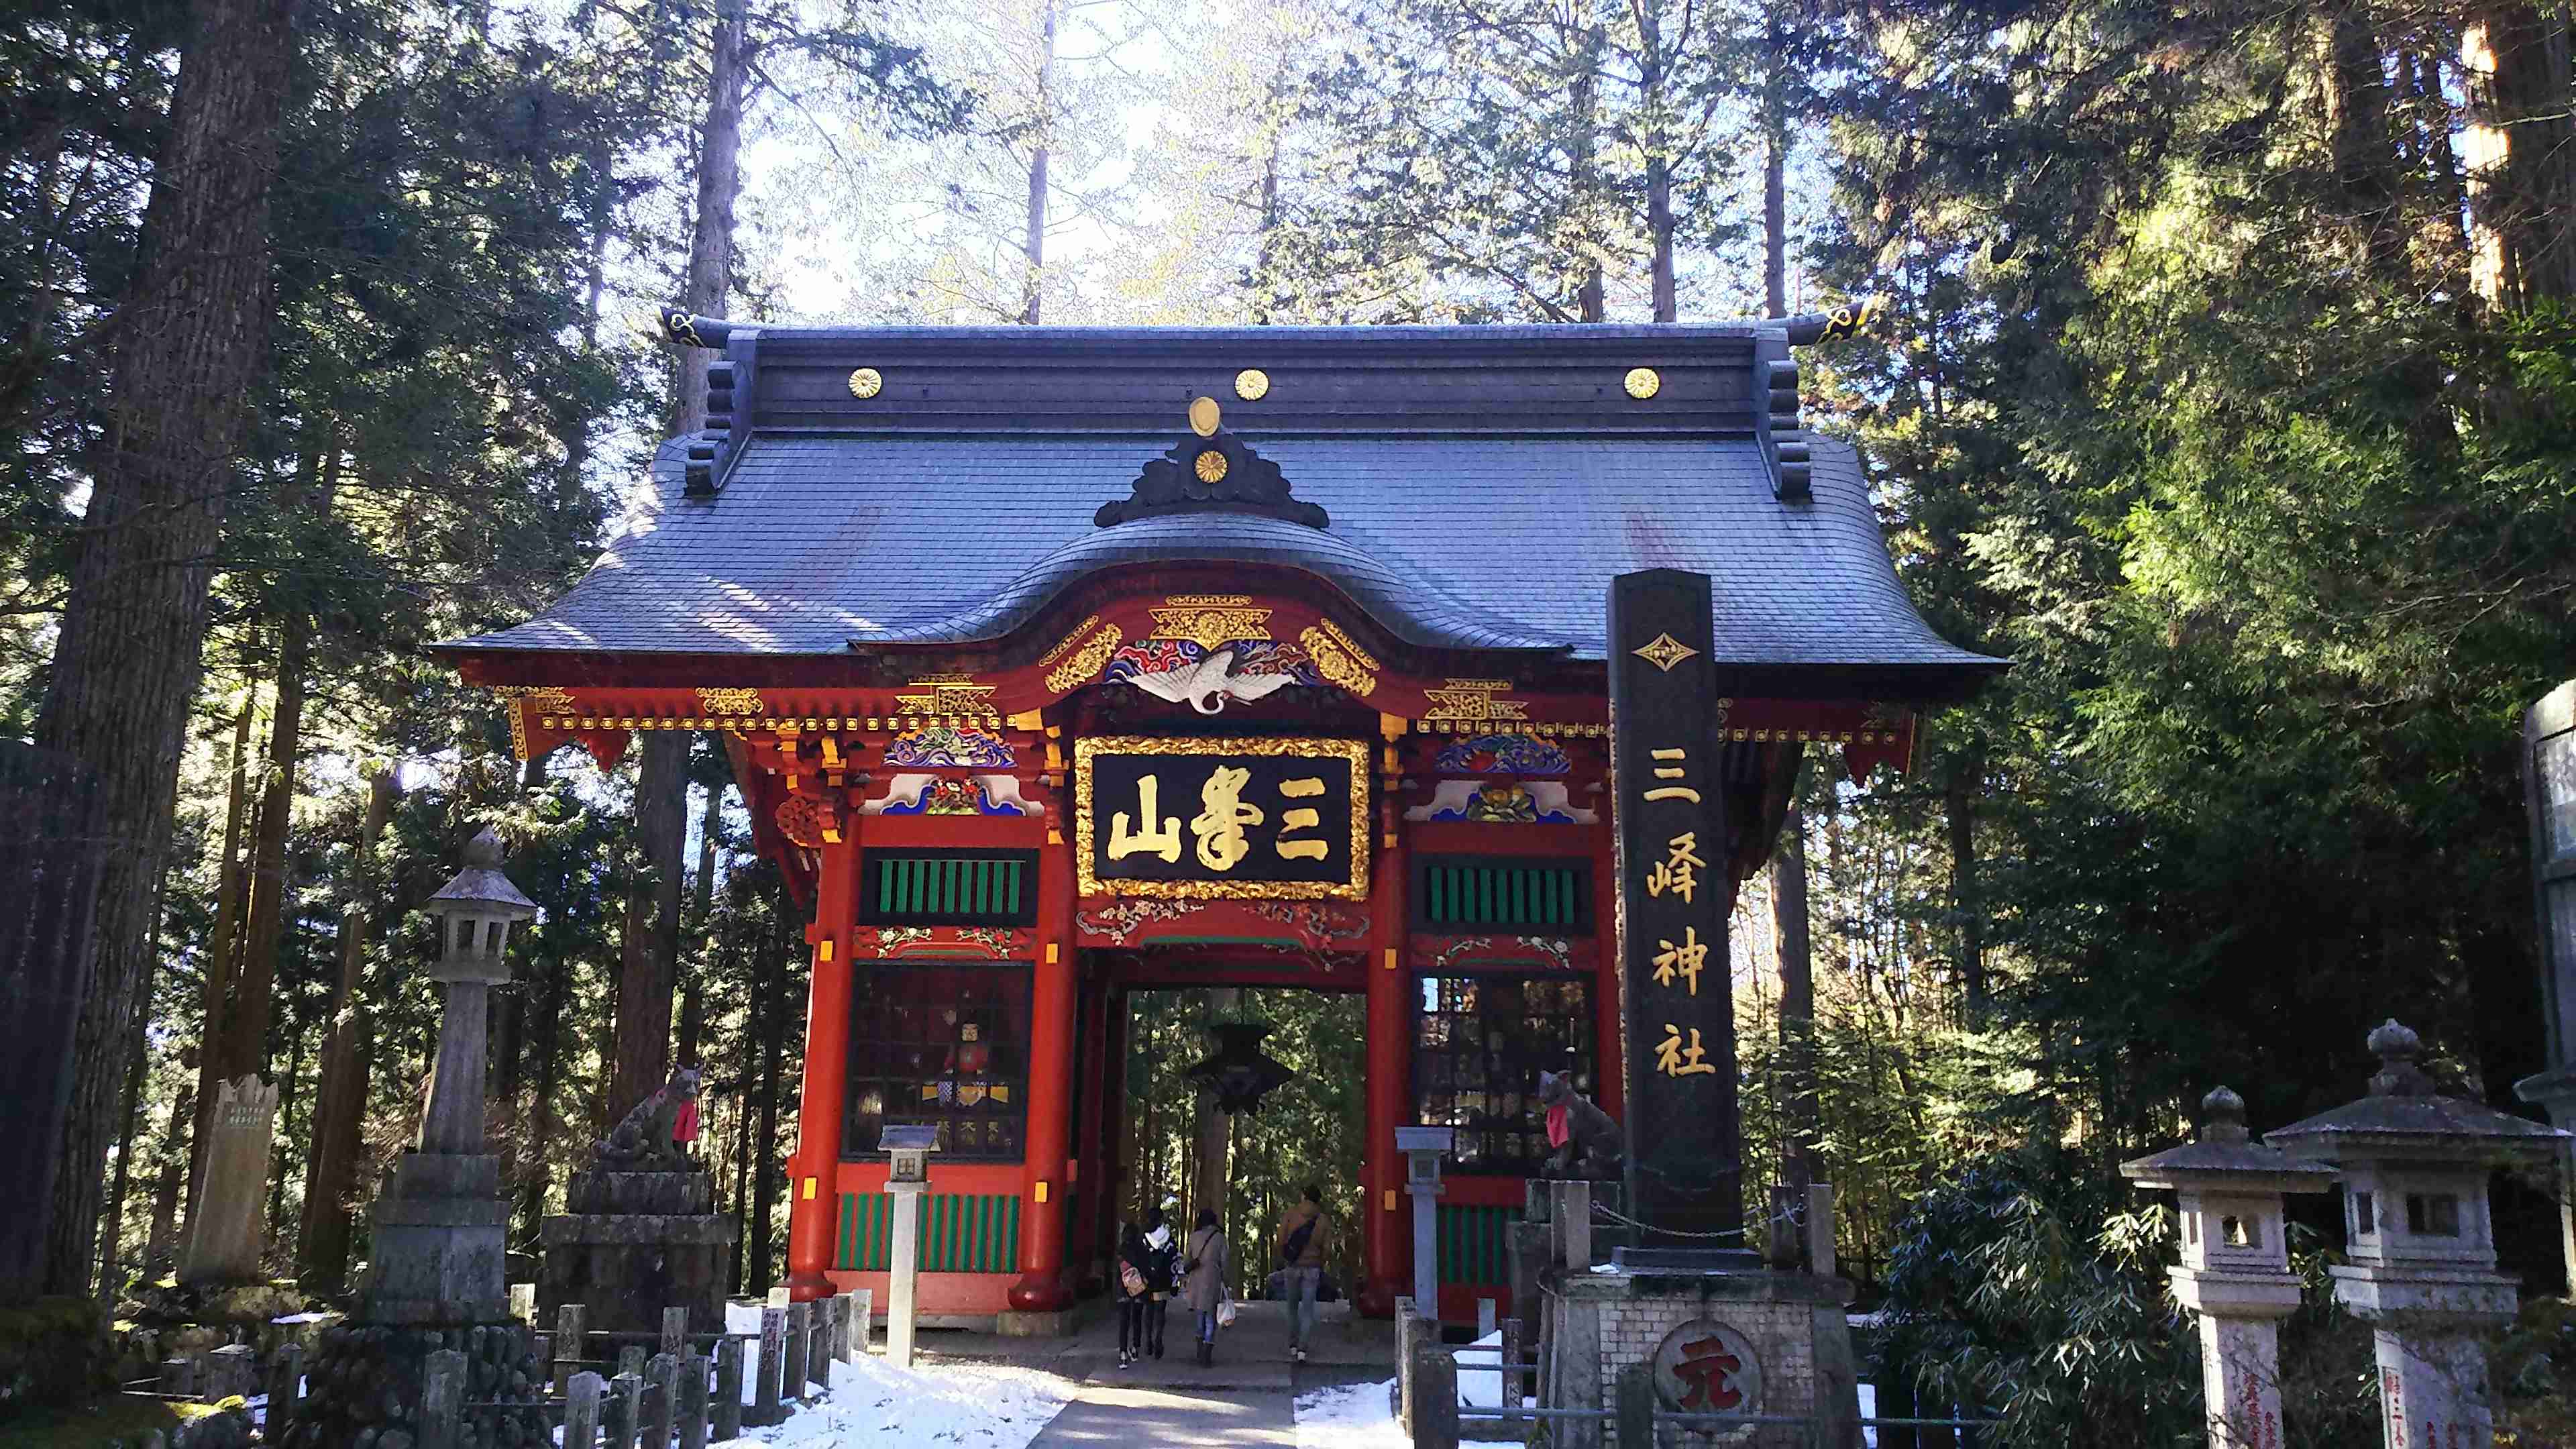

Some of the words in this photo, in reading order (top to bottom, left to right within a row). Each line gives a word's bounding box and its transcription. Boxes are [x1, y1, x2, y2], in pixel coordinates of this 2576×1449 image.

[1643, 747, 1716, 1078] 三峰神社
[1672, 1336, 1742, 1409] 元
